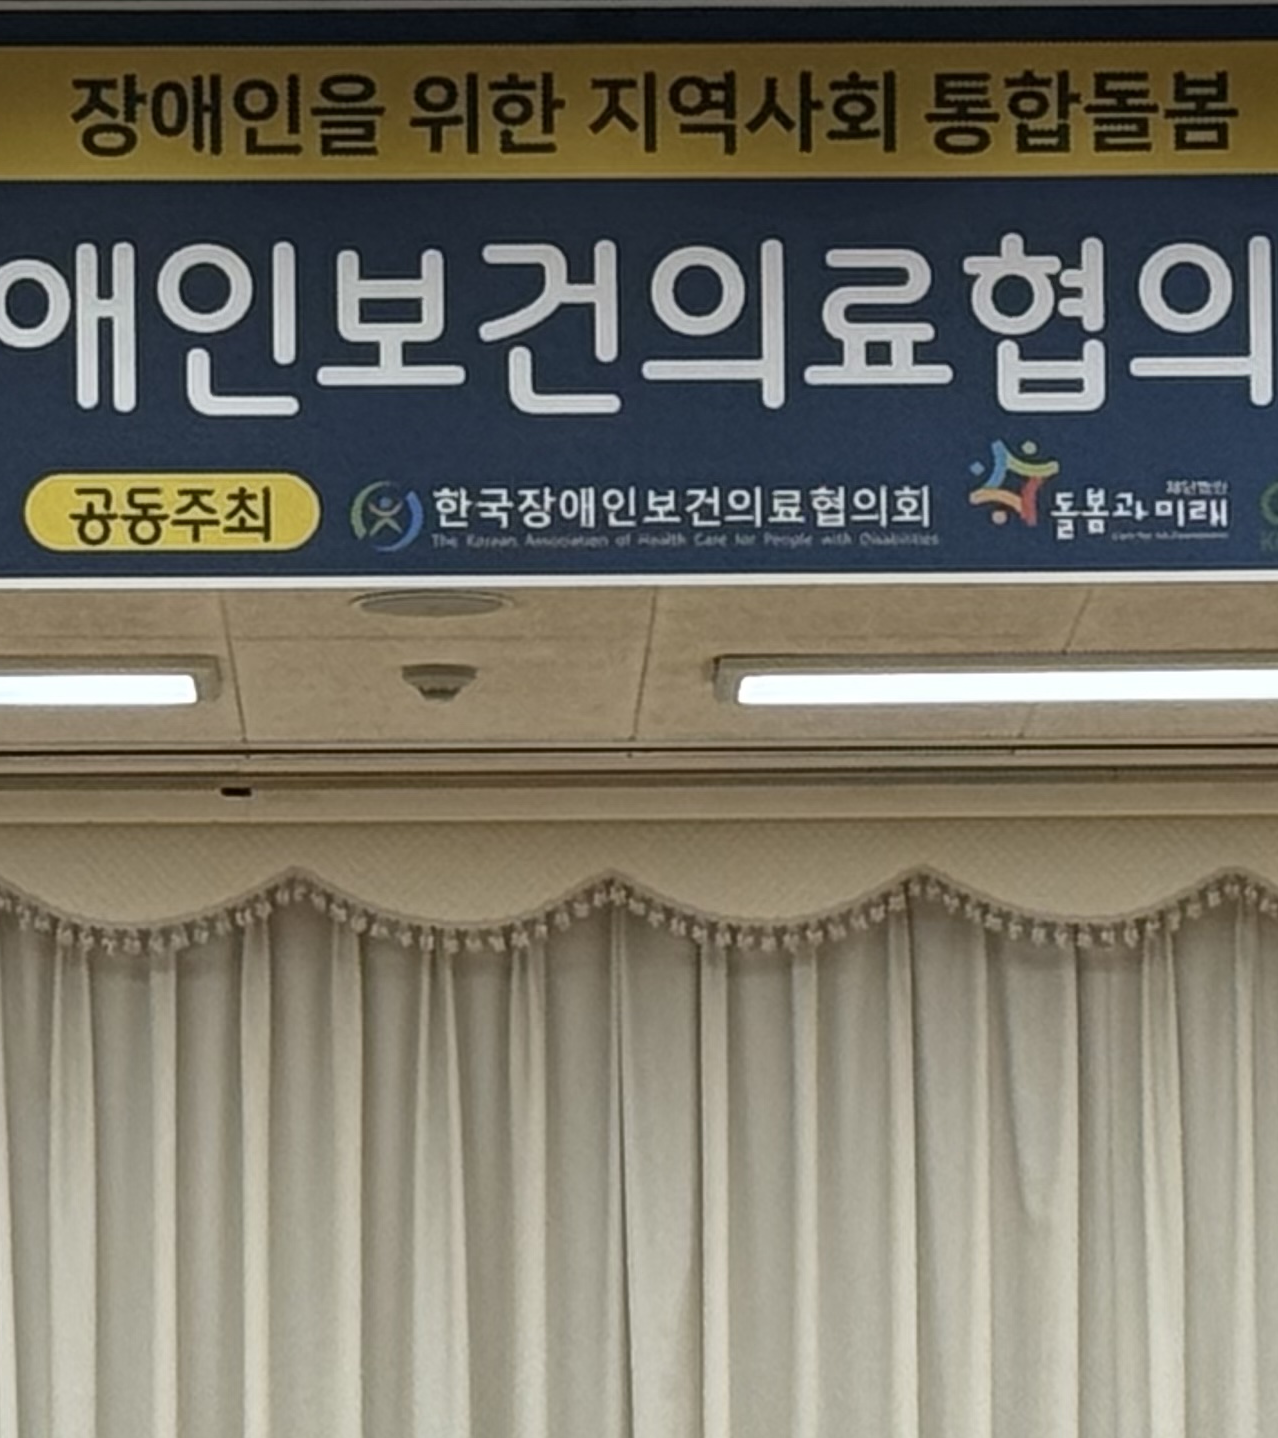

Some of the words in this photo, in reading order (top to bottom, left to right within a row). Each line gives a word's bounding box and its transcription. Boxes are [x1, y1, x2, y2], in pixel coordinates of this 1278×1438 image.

[71, 73, 386, 156] 장애인을
[410, 71, 565, 153] 위한
[590, 70, 896, 155] 지역사회
[925, 69, 1239, 154] 통합돌봄
[69, 487, 272, 545] 공동주최
[433, 485, 929, 529] 한국장애인보건의료협의회
